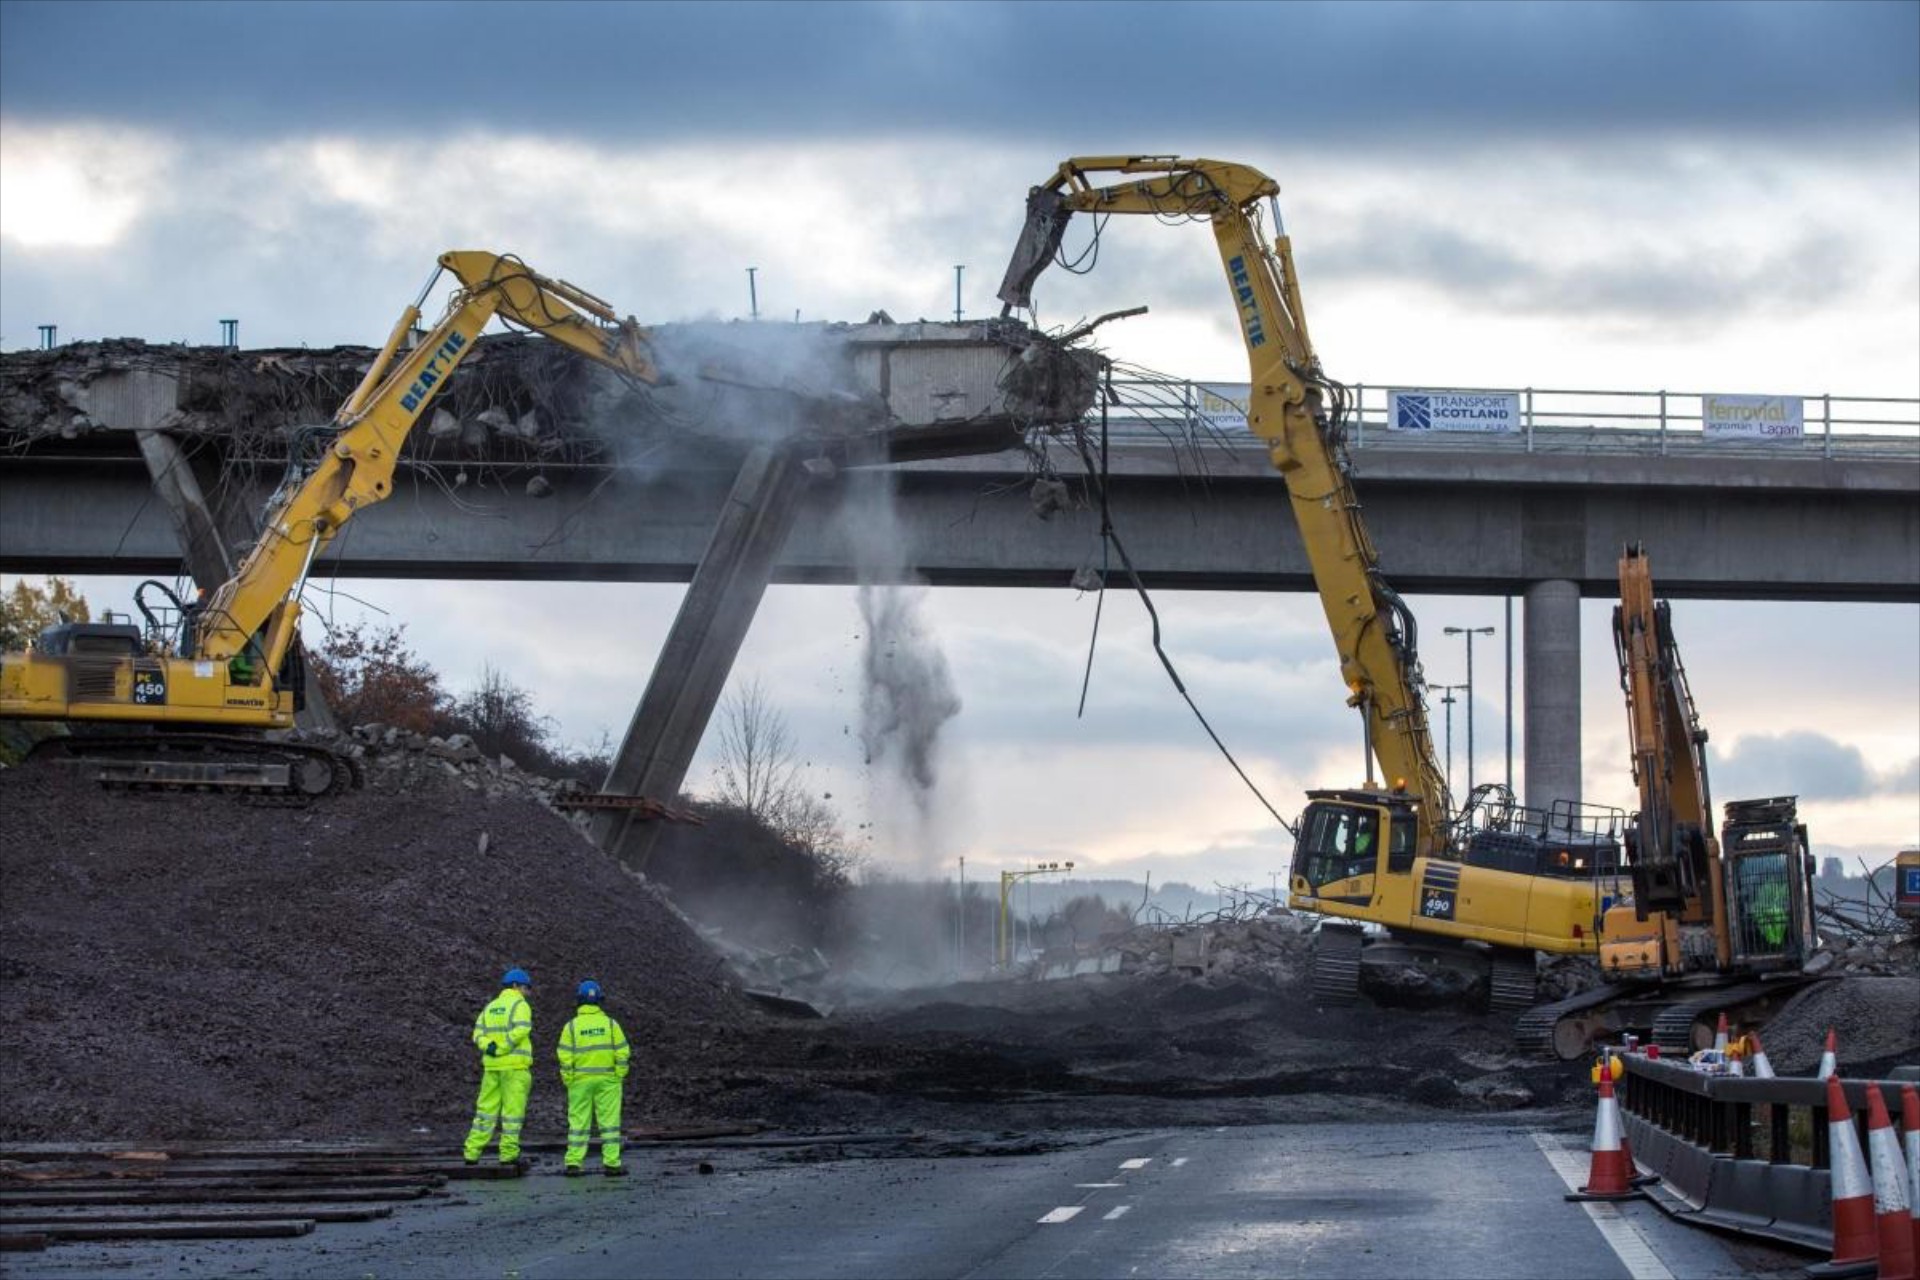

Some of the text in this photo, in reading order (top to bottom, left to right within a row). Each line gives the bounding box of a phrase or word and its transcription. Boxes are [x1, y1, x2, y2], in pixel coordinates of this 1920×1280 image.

[1229, 255, 1266, 349] BEATTIE
[400, 331, 466, 413] BEATTIE
[1432, 396, 1508, 408] TRANSPORT
[1433, 408, 1509, 420] SCOTLAND
[1759, 422, 1800, 436] Lagan
[136, 684, 164, 695] 450
[1427, 899, 1449, 911] 490
